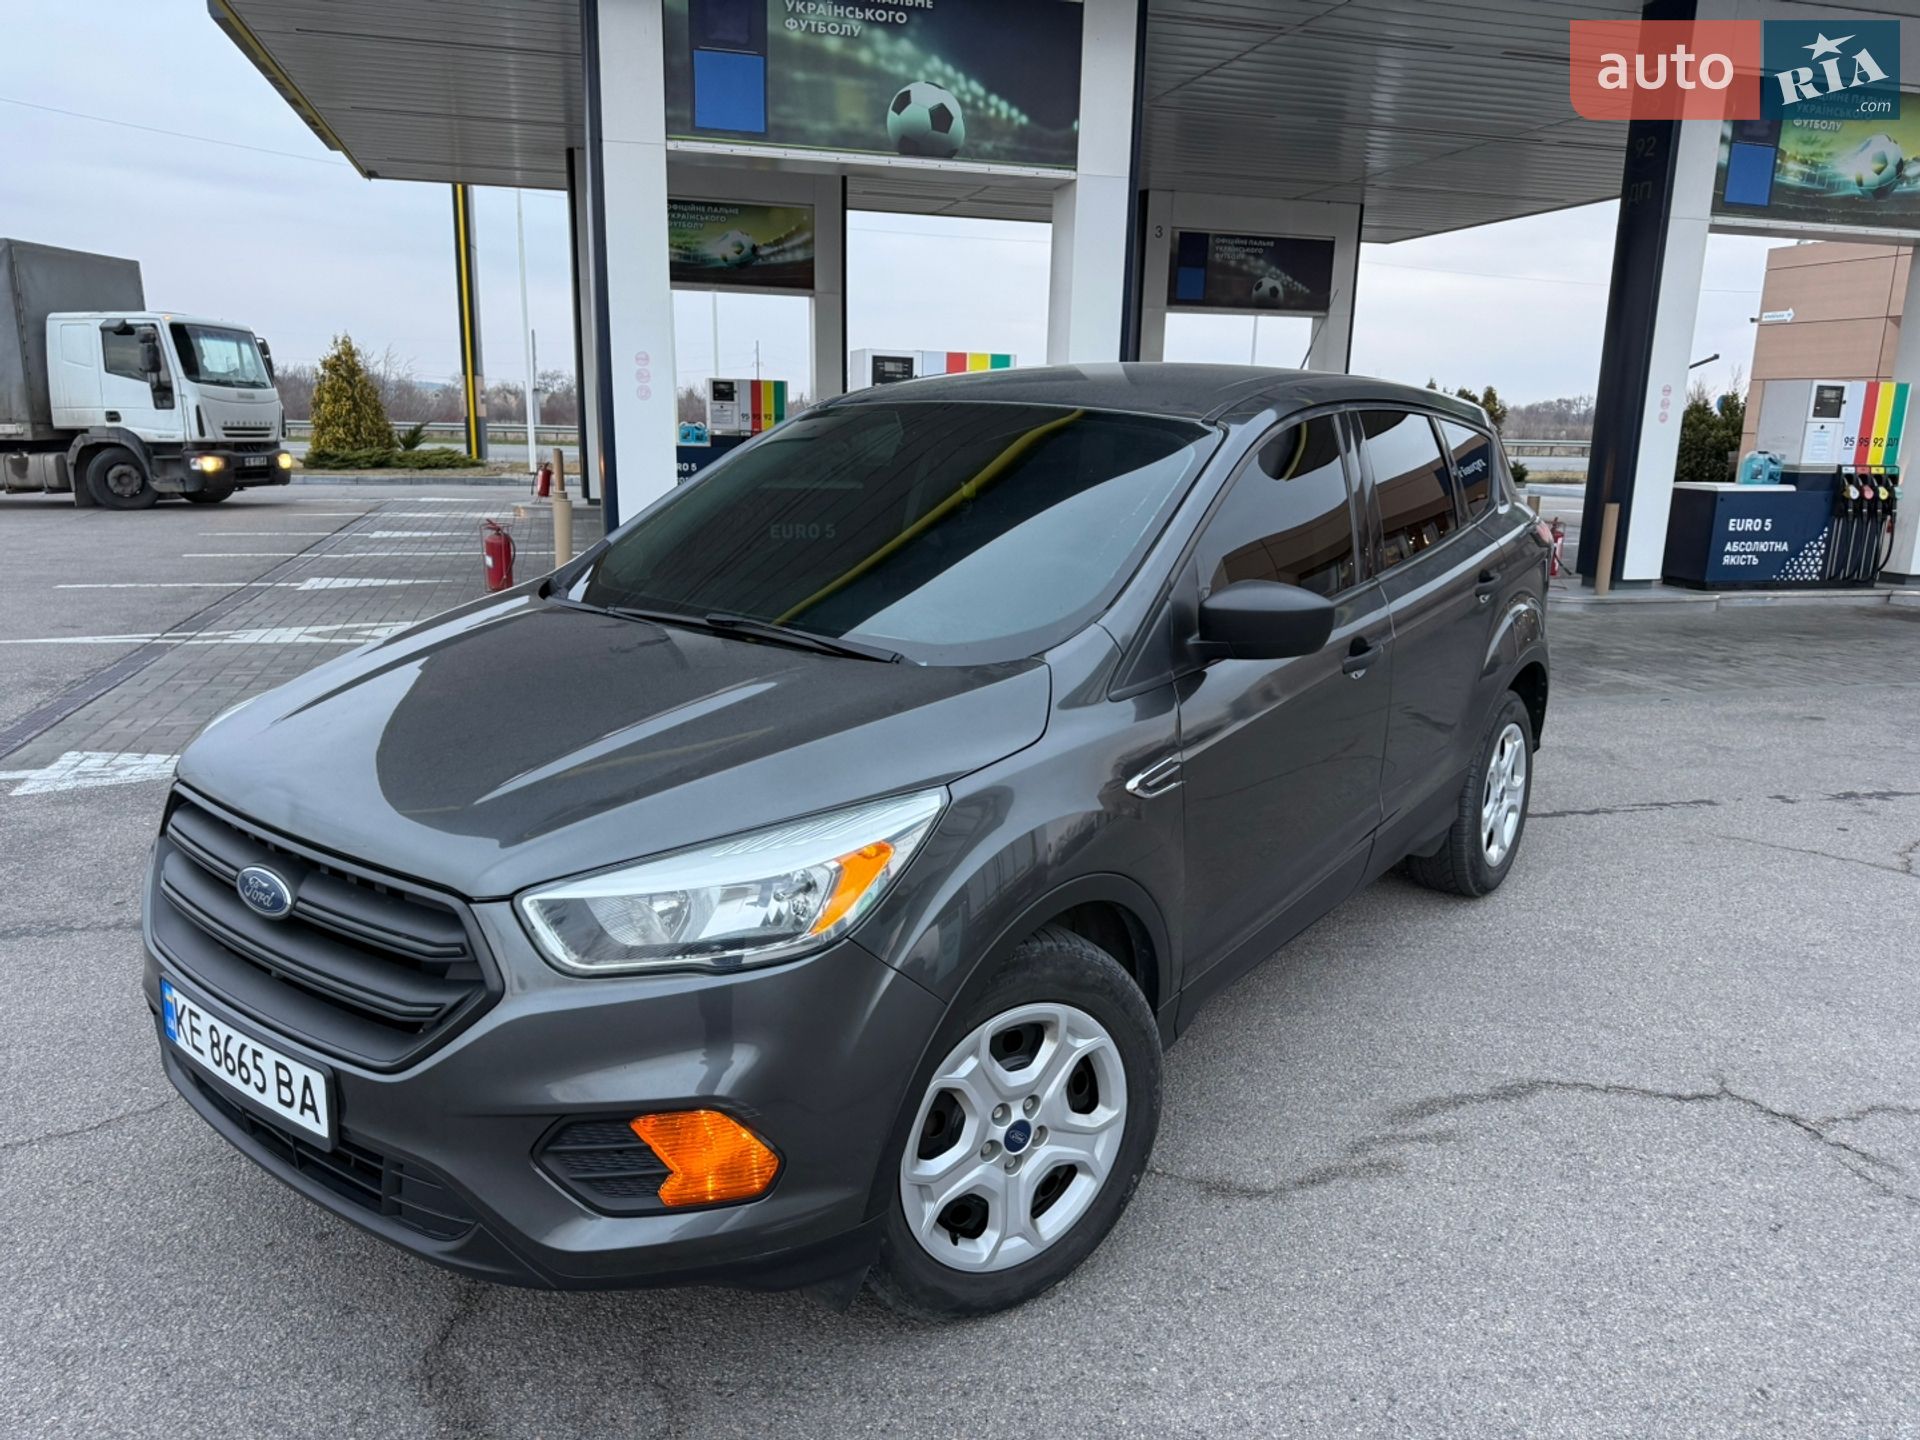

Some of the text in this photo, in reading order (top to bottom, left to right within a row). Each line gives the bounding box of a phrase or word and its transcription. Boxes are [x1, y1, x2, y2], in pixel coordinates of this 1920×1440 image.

[785, 0, 908, 24] УКРАЇНСЬКОГО
[785, 17, 862, 37] ФУТБОЛУ
[1793, 119, 1842, 131] ФУТБОЛУ
[1635, 136, 1656, 158] 92
[1155, 225, 1163, 239] 3
[1843, 436, 1856, 447] 95
[1858, 437, 1870, 448] 95
[1873, 437, 1885, 448] 92
[770, 523, 836, 540] EURO 5
[1728, 518, 1773, 532] EURO 5
[1724, 541, 1789, 552] АБСОЛЮТНА
[1722, 554, 1759, 566] ЯКІСТЬ
[244, 875, 275, 907] Ford
[174, 996, 321, 1126] KE 8665 BA
